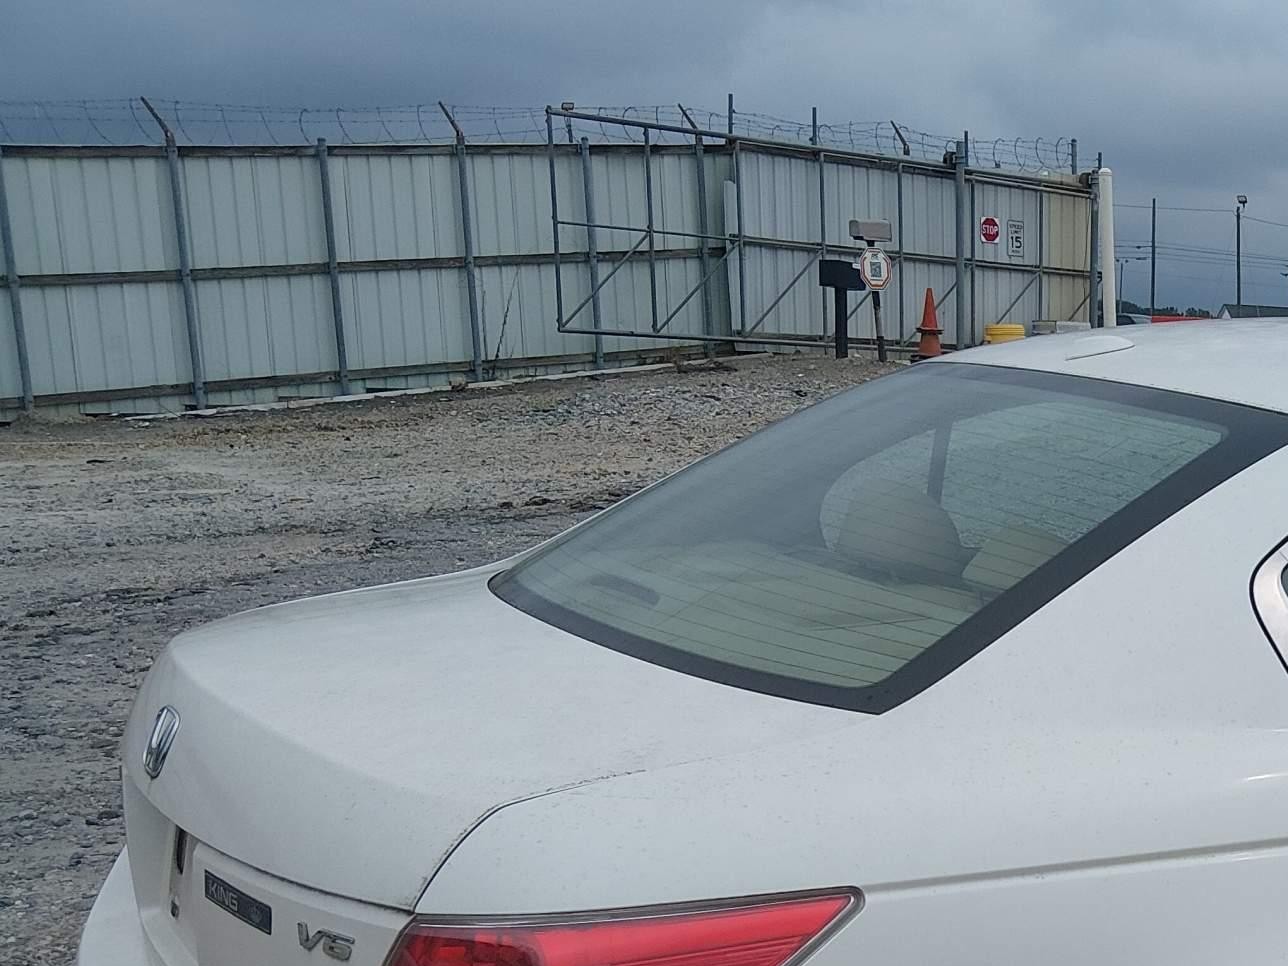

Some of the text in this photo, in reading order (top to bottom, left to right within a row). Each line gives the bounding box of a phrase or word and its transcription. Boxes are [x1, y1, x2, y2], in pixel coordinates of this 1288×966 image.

[982, 224, 998, 235] STOP
[1010, 236, 1022, 249] 15
[208, 879, 239, 912] KING
[297, 921, 356, 962] V6
